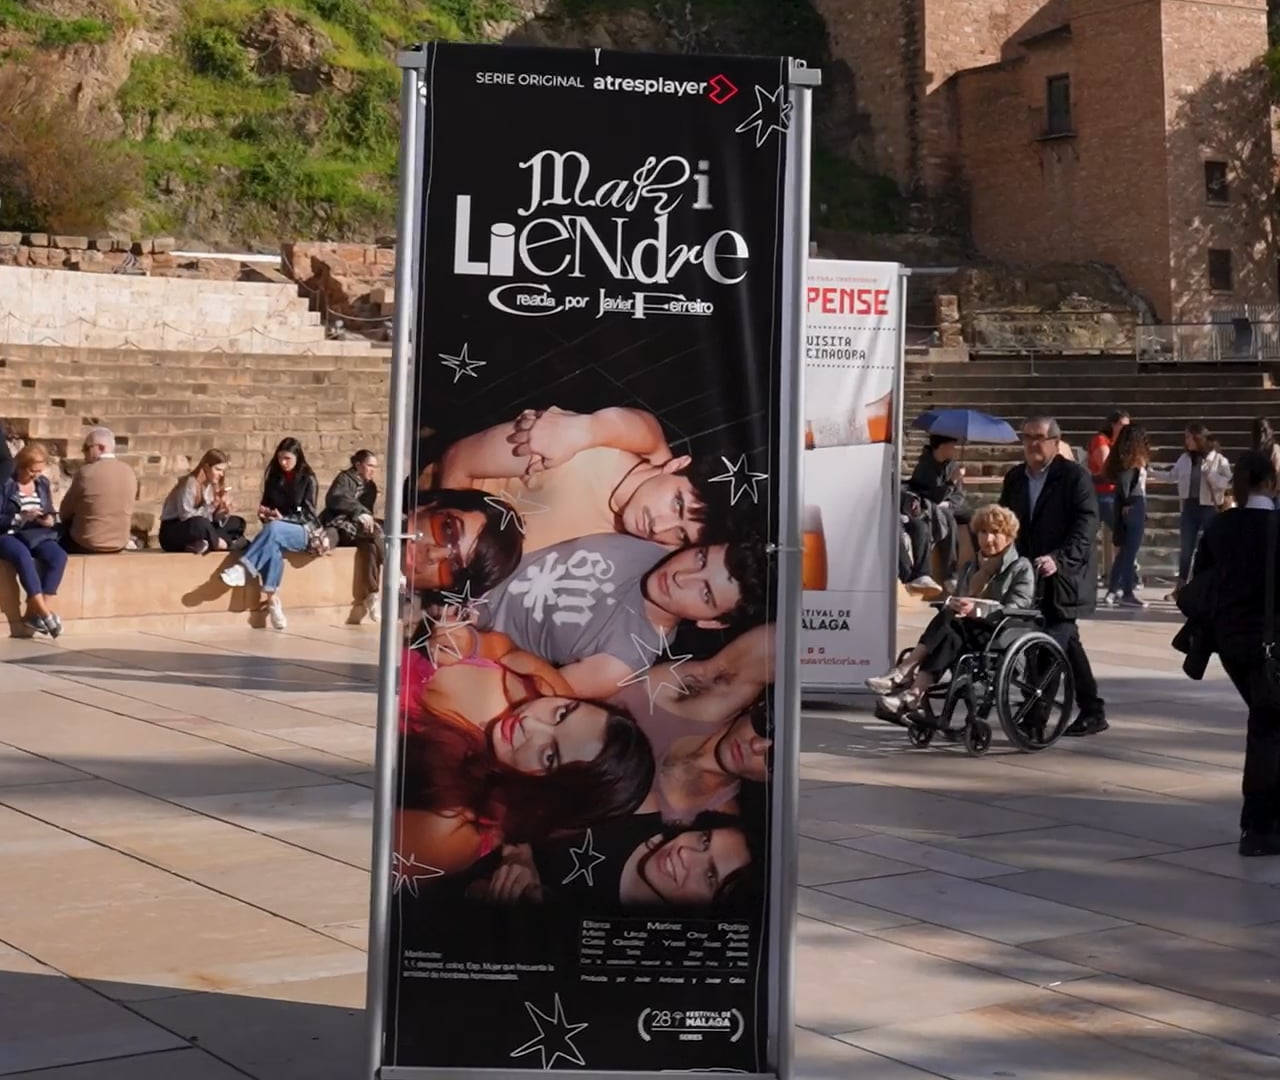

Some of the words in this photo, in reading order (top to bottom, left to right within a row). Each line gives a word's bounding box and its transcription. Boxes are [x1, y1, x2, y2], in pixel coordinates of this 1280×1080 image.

[476, 72, 515, 85] SERIE
[518, 73, 585, 88] ORIGINAL
[593, 76, 708, 96] atresplayer
[488, 283, 565, 316] Creada
[564, 295, 590, 311] por
[595, 288, 634, 319] Javier
[632, 291, 714, 319] Ferreiro
[838, 610, 851, 618] DE
[651, 1010, 671, 1027] 28
